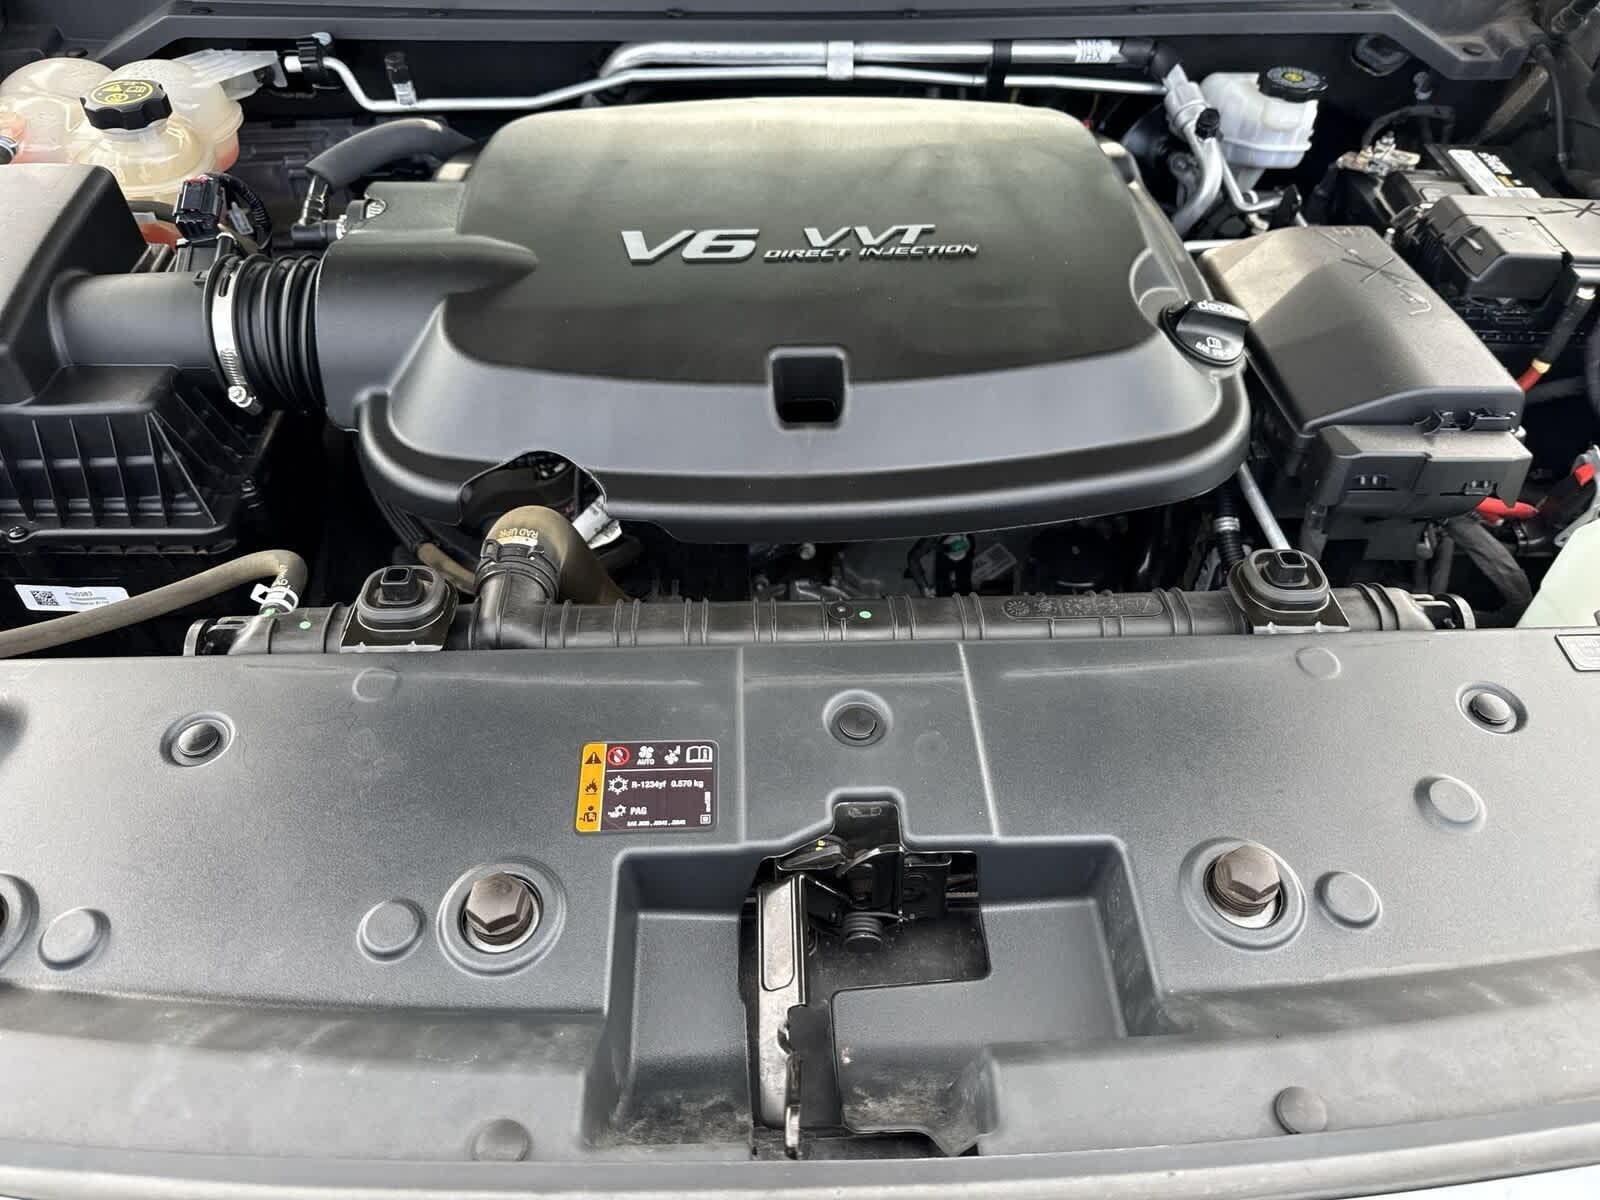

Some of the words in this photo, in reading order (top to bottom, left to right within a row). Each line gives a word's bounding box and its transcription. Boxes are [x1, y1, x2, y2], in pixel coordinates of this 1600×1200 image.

[804, 224, 936, 247] VVT
[621, 228, 759, 262] V6
[763, 247, 852, 260] DIRECT
[858, 243, 979, 258] INJECTION
[519, 528, 539, 539] RAD
[693, 779, 704, 788] kg
[630, 806, 648, 815] PAG
